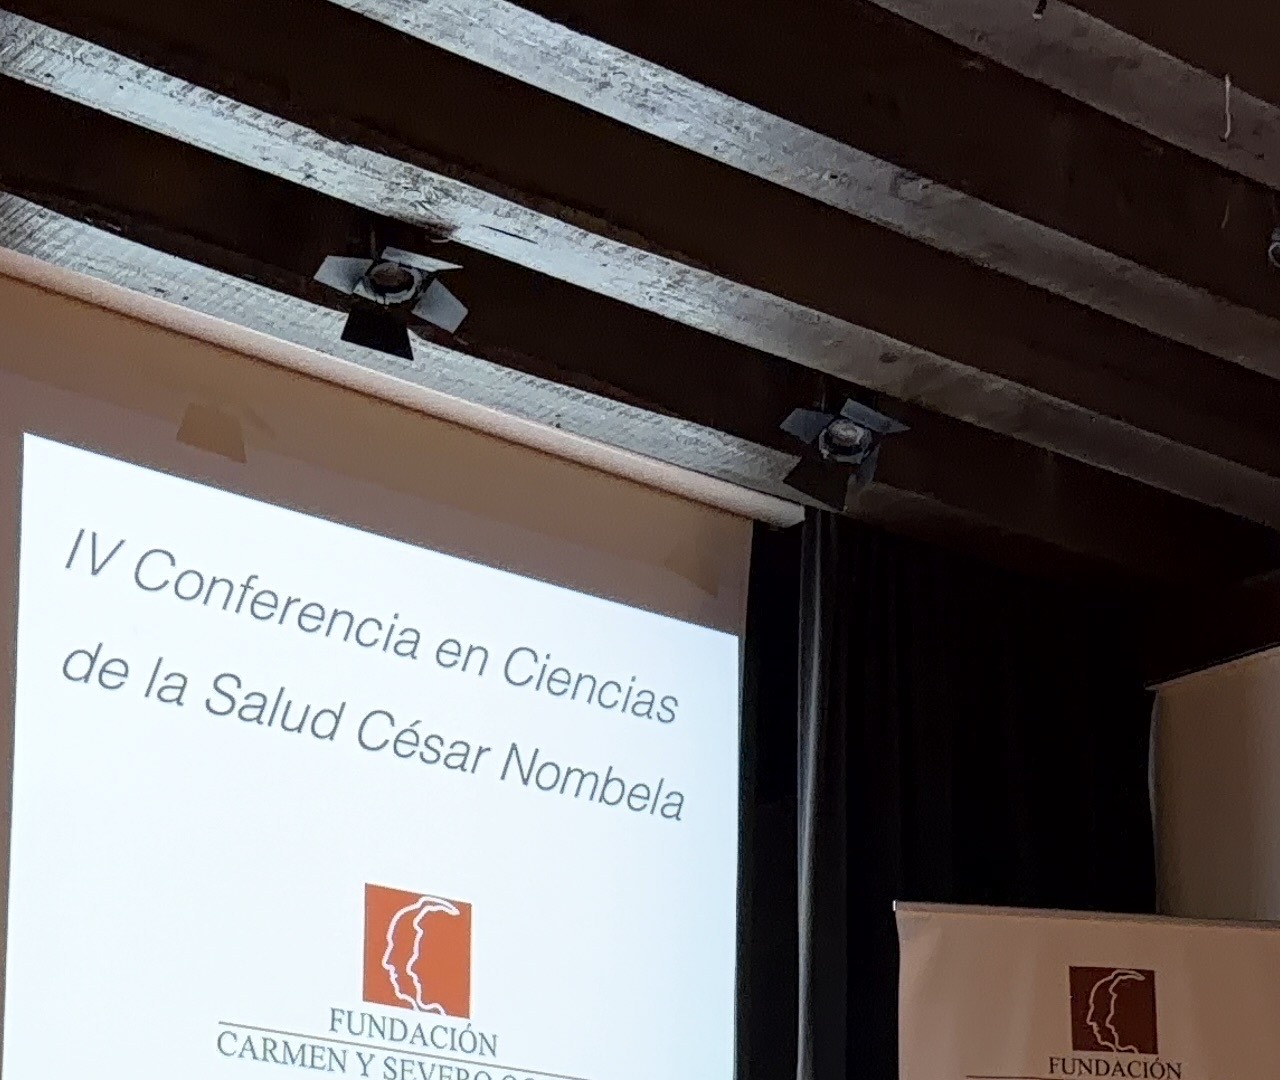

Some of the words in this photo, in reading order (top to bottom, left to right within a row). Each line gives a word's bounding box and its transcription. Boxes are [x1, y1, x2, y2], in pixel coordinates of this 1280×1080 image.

[65, 529, 125, 577] IV
[134, 549, 421, 660] Conferencia
[436, 638, 488, 676] en
[504, 647, 678, 724] Ciencias
[63, 643, 129, 691] de
[145, 657, 185, 706] la
[206, 672, 344, 741] Salud
[358, 710, 490, 774] César
[501, 742, 684, 822] Nombela
[217, 1030, 347, 1073] CARMEN
[356, 1051, 375, 1077] Y
[329, 1008, 497, 1057] FUNDACIÓN
[1049, 1056, 1181, 1080] FUNDACIÓN
